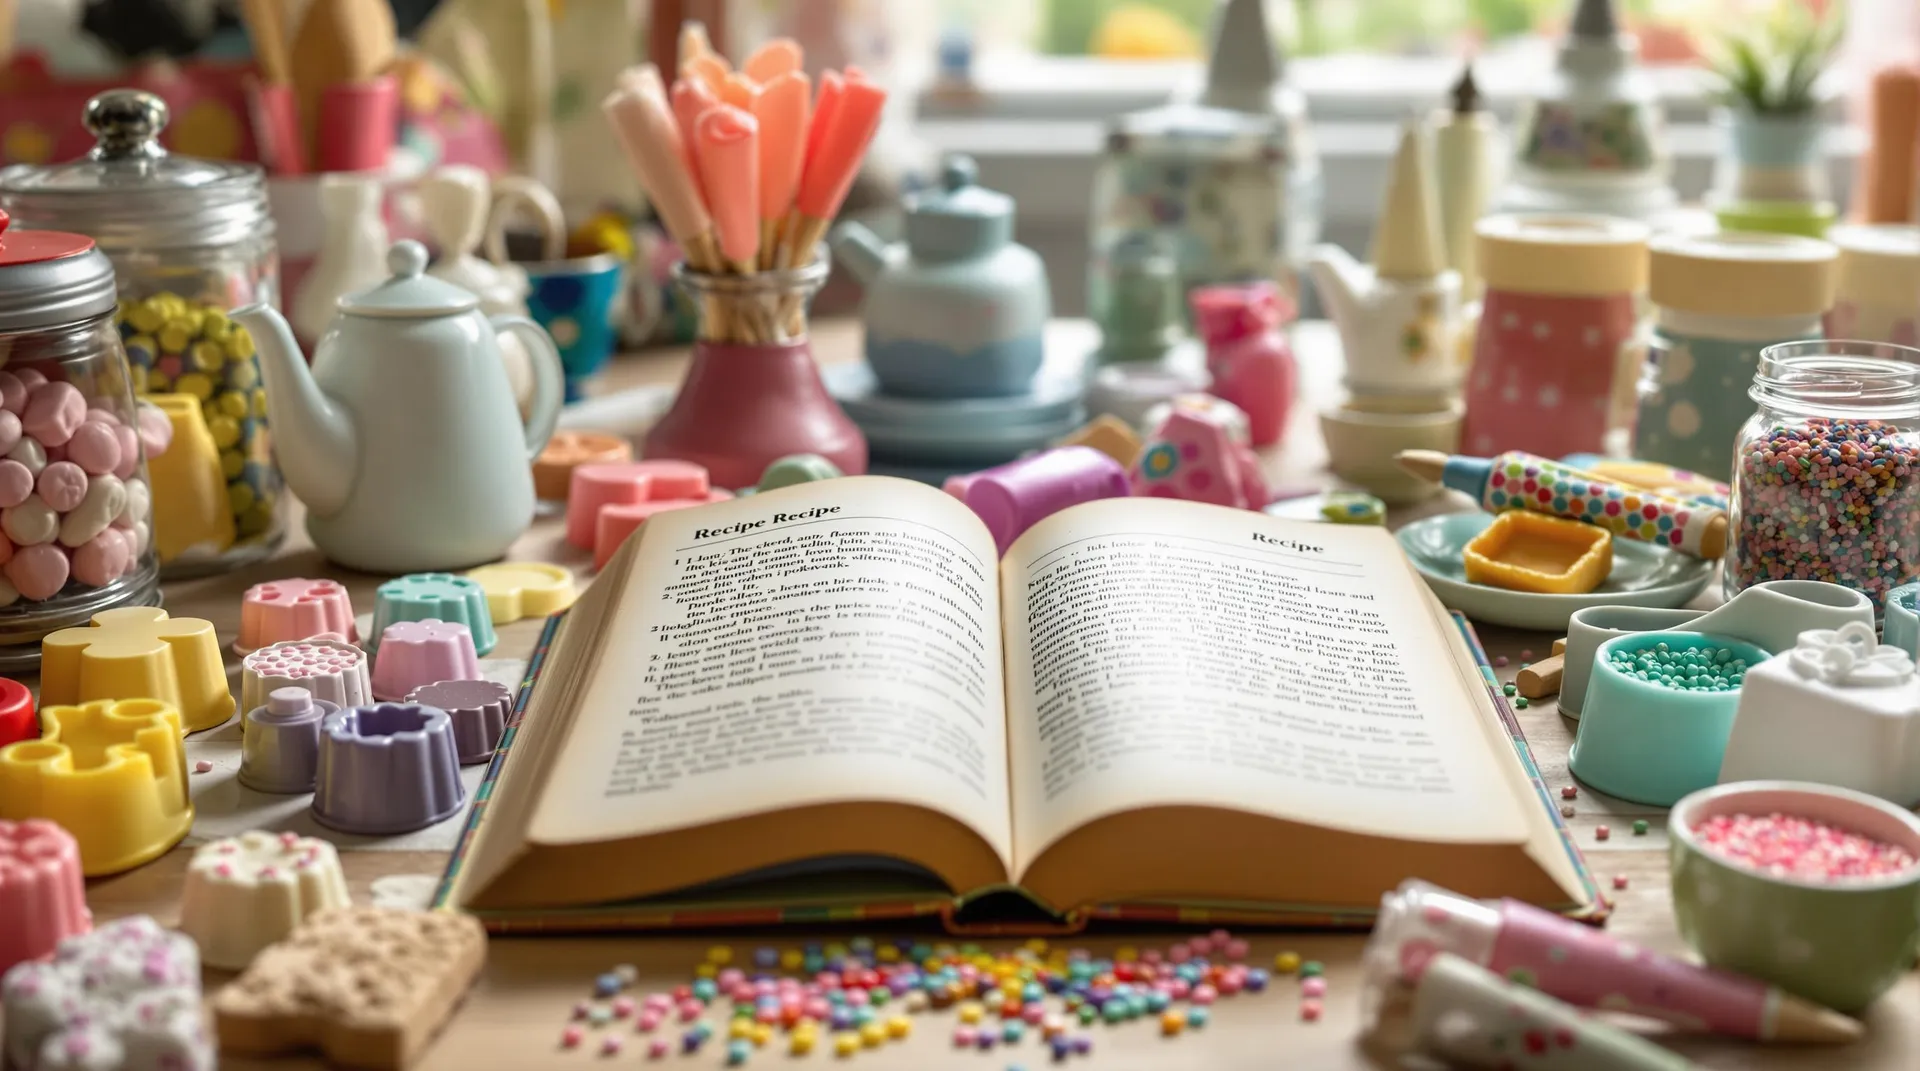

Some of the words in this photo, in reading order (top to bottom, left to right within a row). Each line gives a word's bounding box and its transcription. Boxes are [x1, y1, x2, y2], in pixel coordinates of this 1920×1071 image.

[694, 522, 766, 540] Recipe
[773, 506, 841, 524] Recipe
[1252, 532, 1324, 554] Recipe
